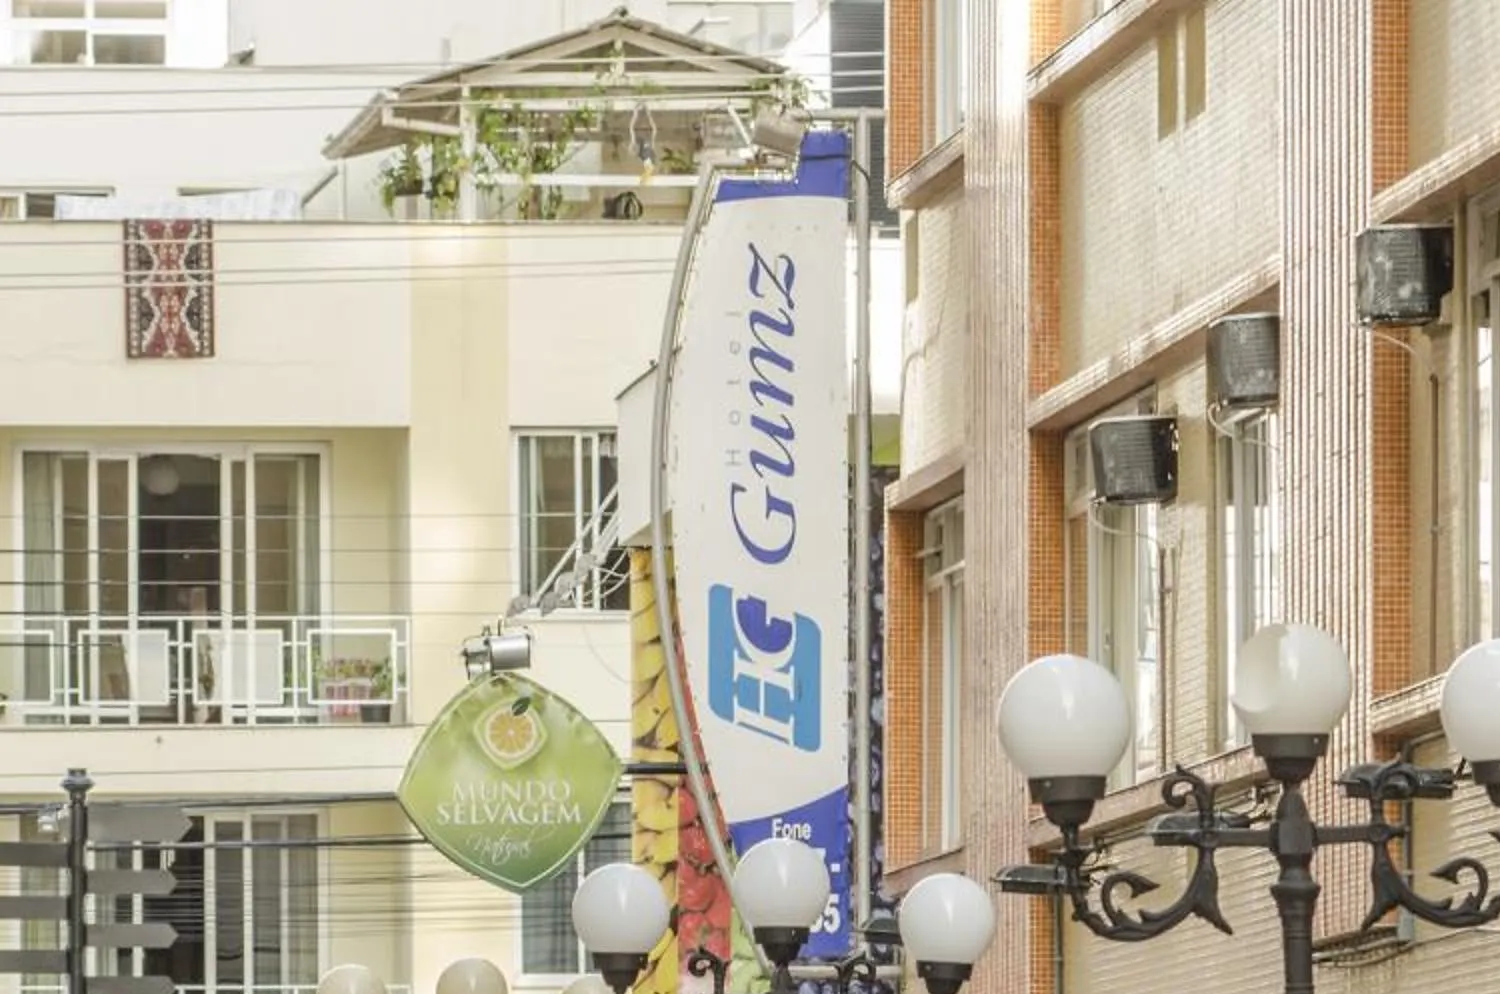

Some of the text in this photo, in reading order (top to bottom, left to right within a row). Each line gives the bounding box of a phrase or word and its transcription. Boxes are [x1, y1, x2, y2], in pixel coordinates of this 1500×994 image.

[726, 310, 741, 465] Hotel
[730, 242, 796, 565] Gumz
[453, 780, 571, 802] MUNDO
[437, 801, 581, 825] SELVAGEM
[771, 818, 812, 840] Fone
